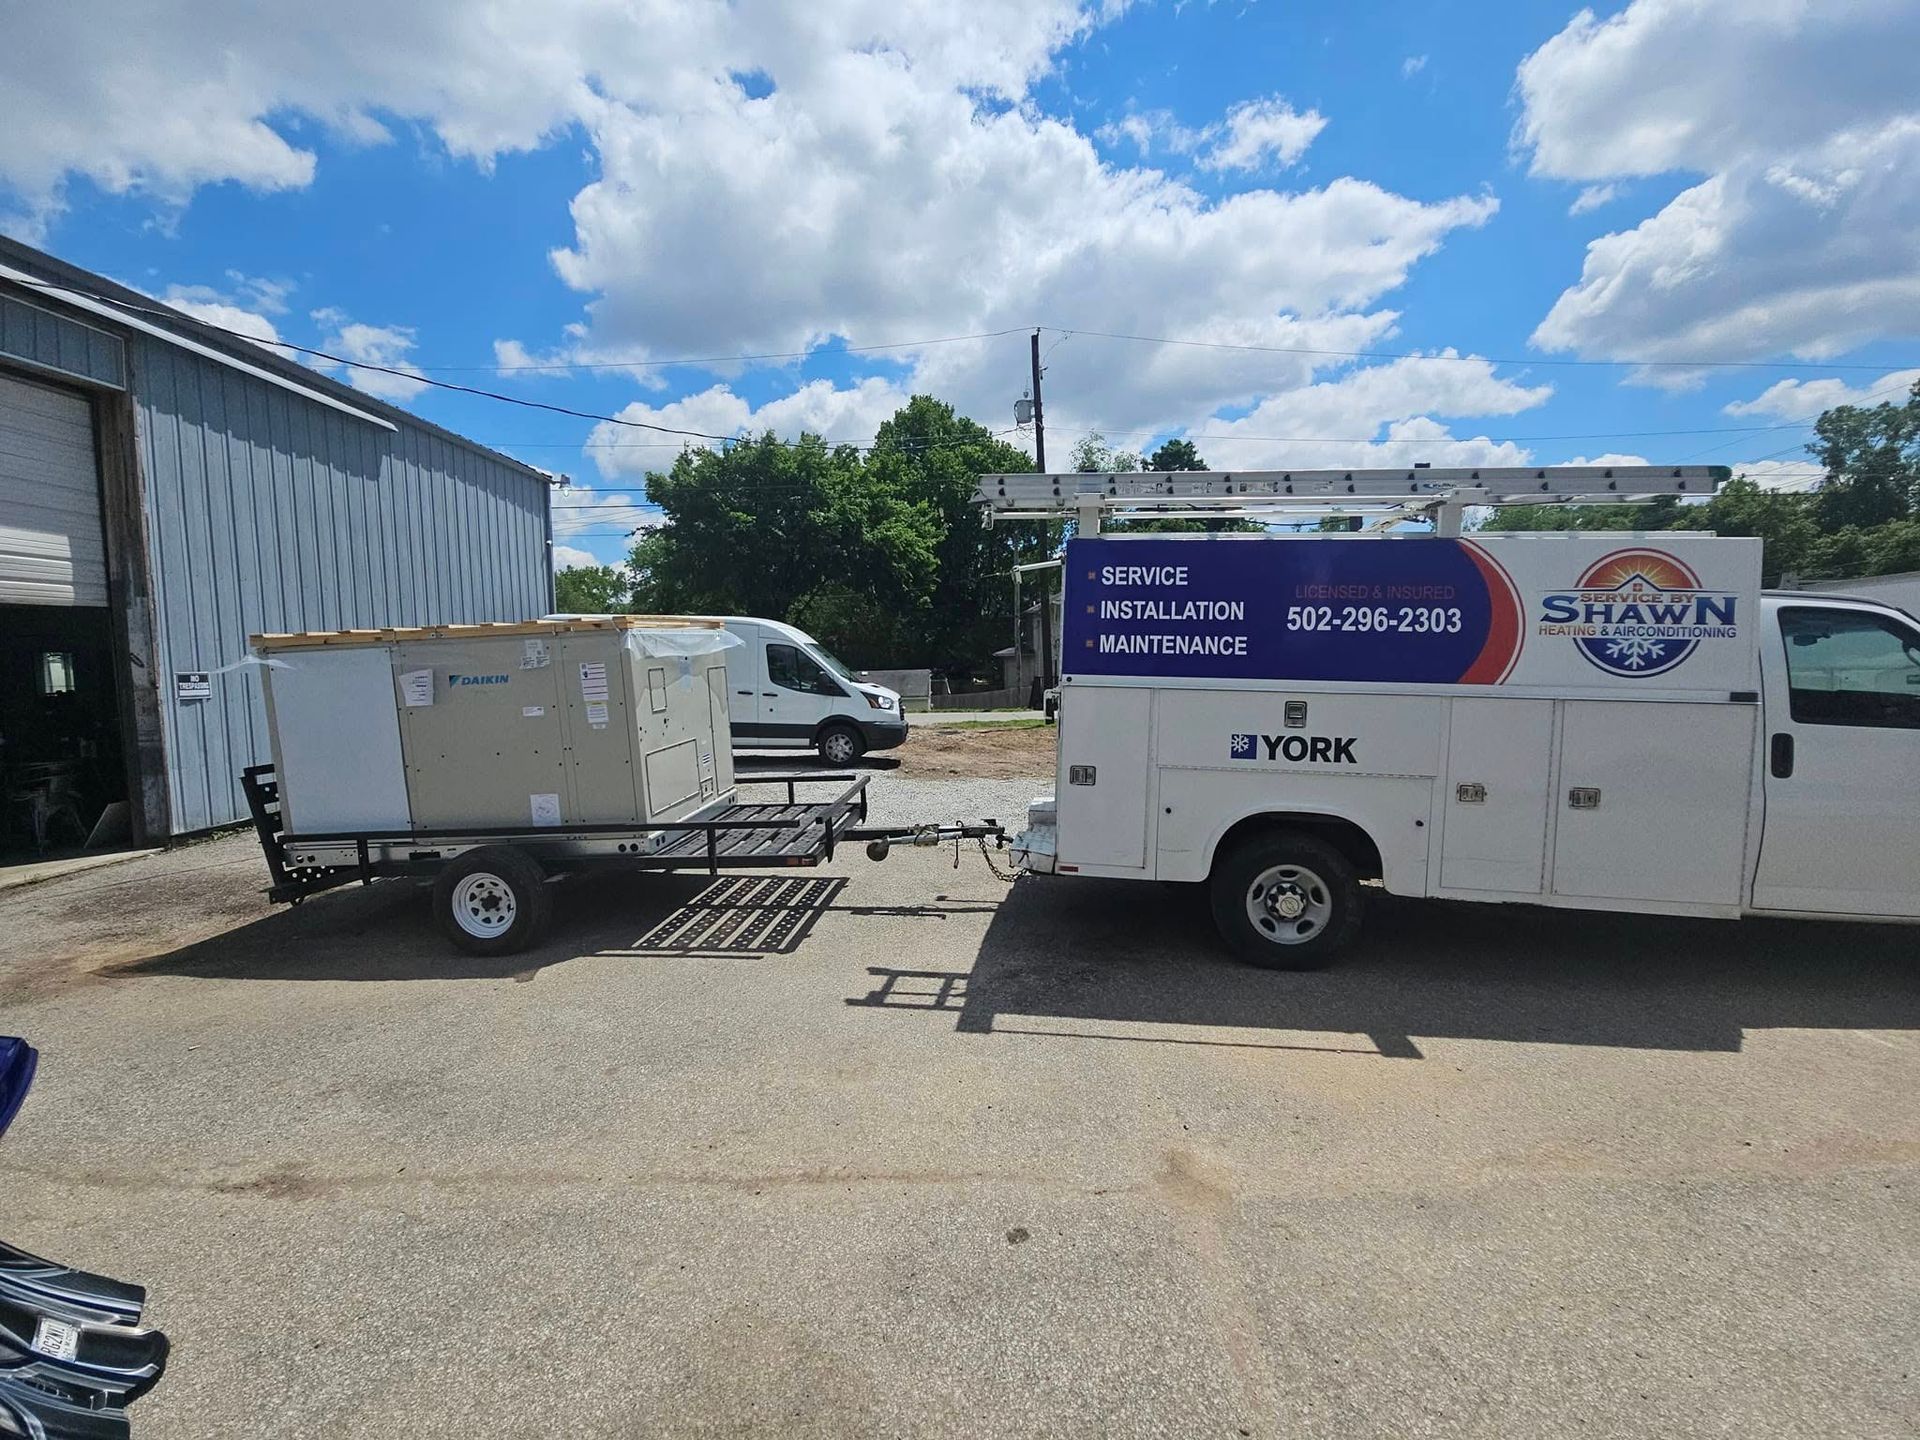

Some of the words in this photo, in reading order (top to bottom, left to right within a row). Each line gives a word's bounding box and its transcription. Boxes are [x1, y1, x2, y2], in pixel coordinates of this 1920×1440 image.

[1101, 566, 1189, 586] SERVICE
[1295, 584, 1369, 599] LICENSED
[1372, 585, 1383, 599] &
[1386, 585, 1456, 600] INSURED
[1580, 593, 1664, 603] SERVICE
[1670, 593, 1697, 603] BY
[1100, 600, 1245, 621] INSTALLATION
[1286, 606, 1463, 633] 502-296-2303
[1540, 594, 1739, 626] SHAWN
[1538, 624, 1597, 636] HEATING
[1600, 626, 1609, 637] &
[1613, 626, 1737, 639] AIRCONDITIONING
[1099, 634, 1248, 656] MAINTENANCE
[190, 675, 200, 683] NO
[461, 674, 510, 686] DAIKIN
[1261, 735, 1358, 764] YORK
